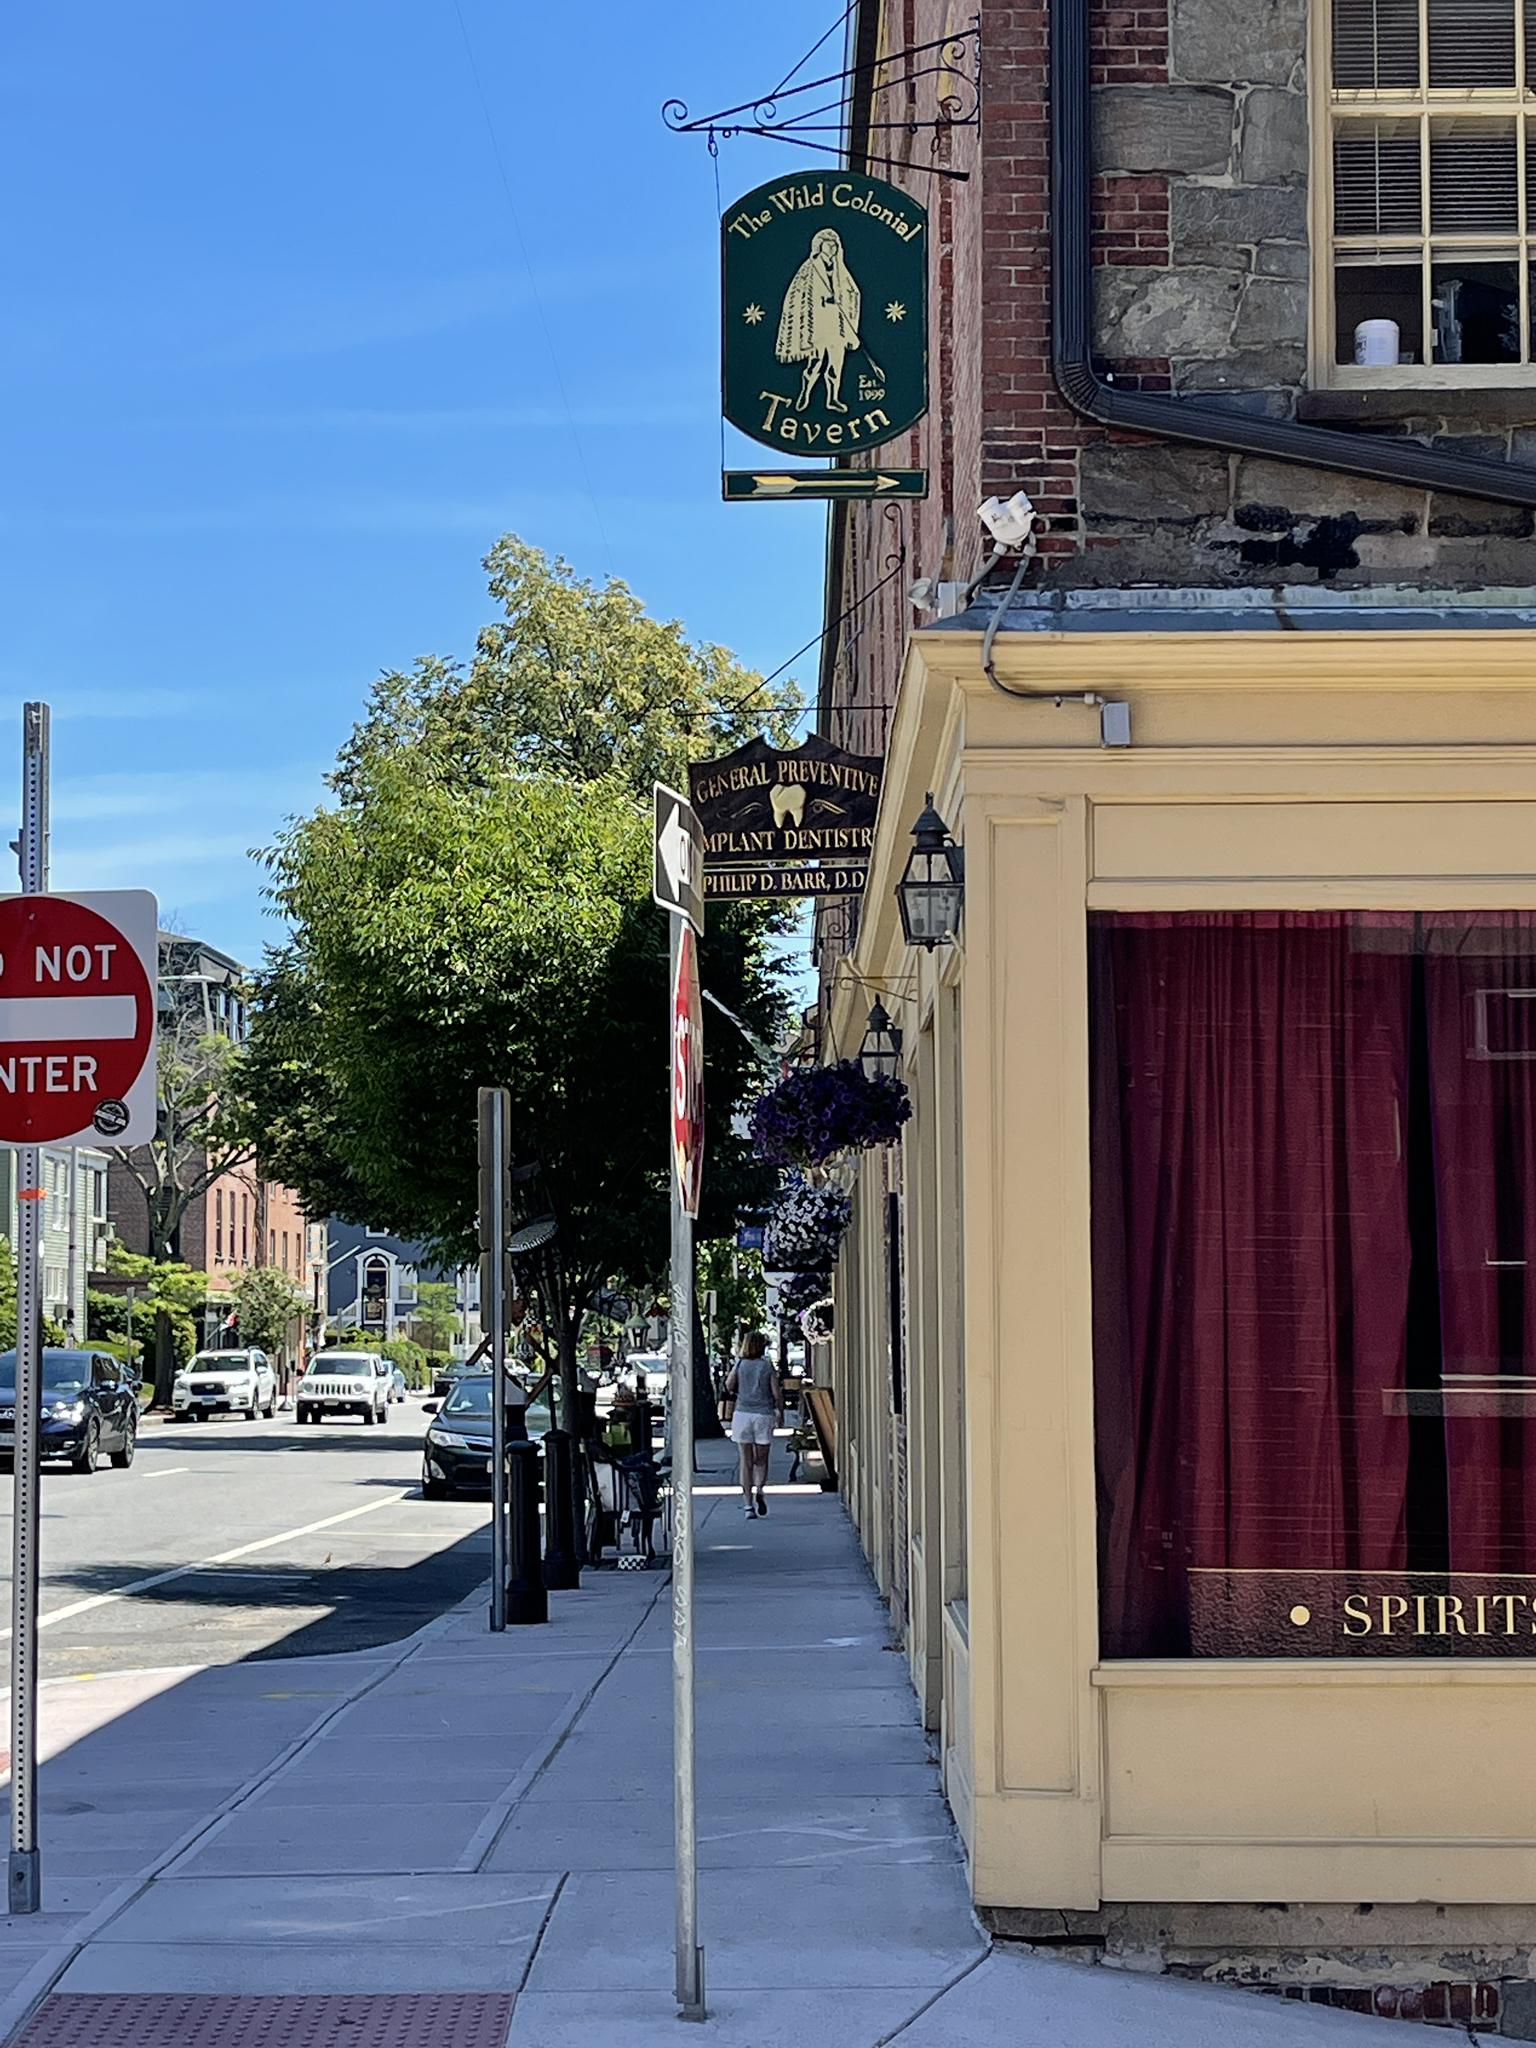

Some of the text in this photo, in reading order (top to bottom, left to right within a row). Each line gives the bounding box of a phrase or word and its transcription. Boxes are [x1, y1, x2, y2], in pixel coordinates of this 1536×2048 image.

[728, 182, 922, 242] The Wild Colonial
[759, 390, 891, 444] Tavern
[696, 760, 879, 804] GENERAL PREVENTIVE
[703, 827, 874, 853] MPLANT DENTISTR
[703, 870, 866, 893] PHILIP D. BARR, D.D
[35, 944, 117, 982] NOT
[0, 1055, 98, 1093] NTER
[1343, 1594, 1536, 1637] SPIRIT
